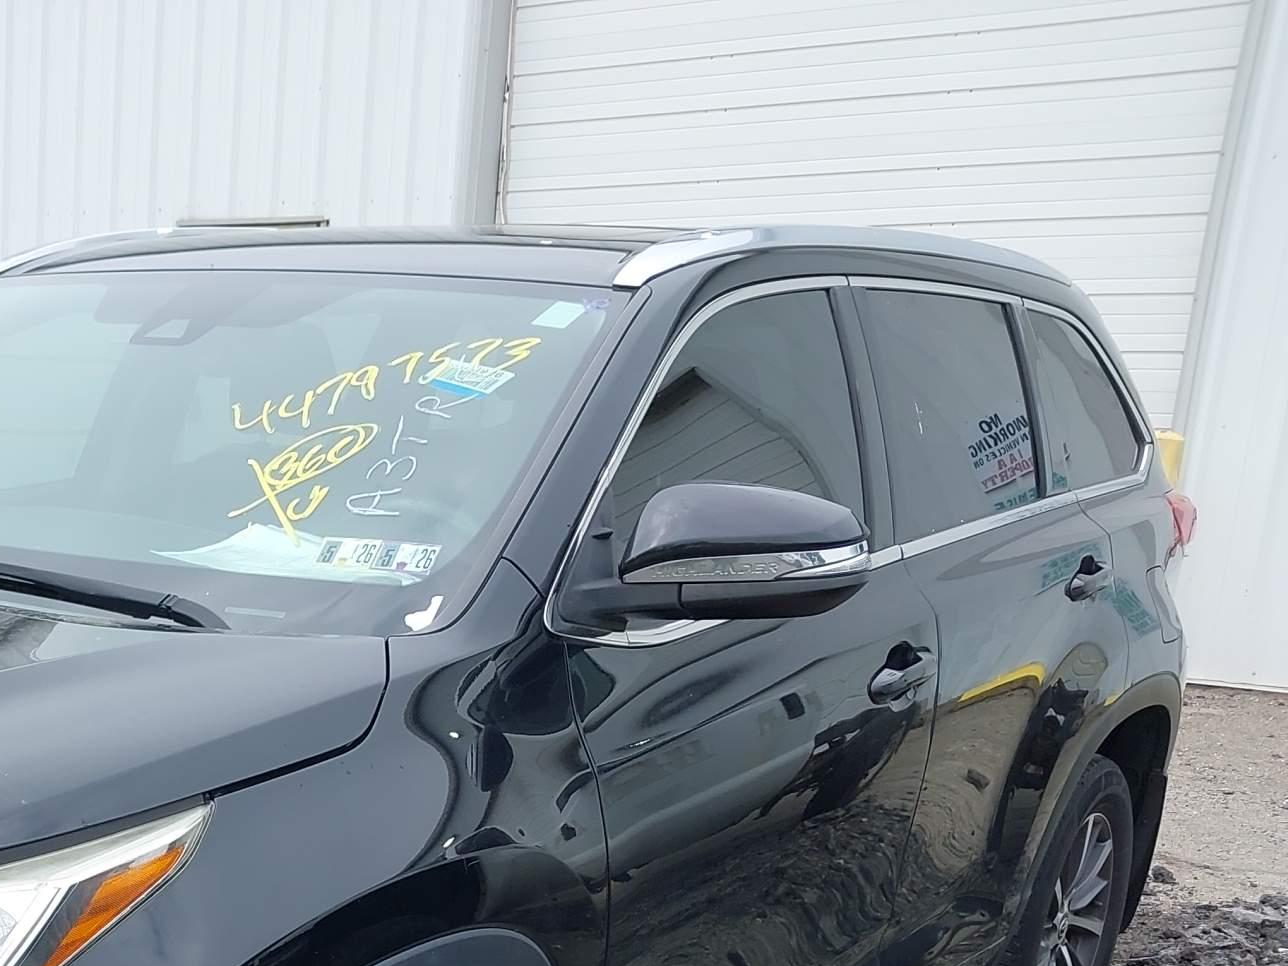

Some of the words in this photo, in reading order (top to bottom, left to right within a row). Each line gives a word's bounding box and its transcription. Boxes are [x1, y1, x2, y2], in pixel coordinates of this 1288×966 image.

[232, 337, 541, 434] 44797573
[356, 543, 377, 564] 26
[415, 549, 437, 569] 26
[652, 562, 781, 578] HIGHLANDER
